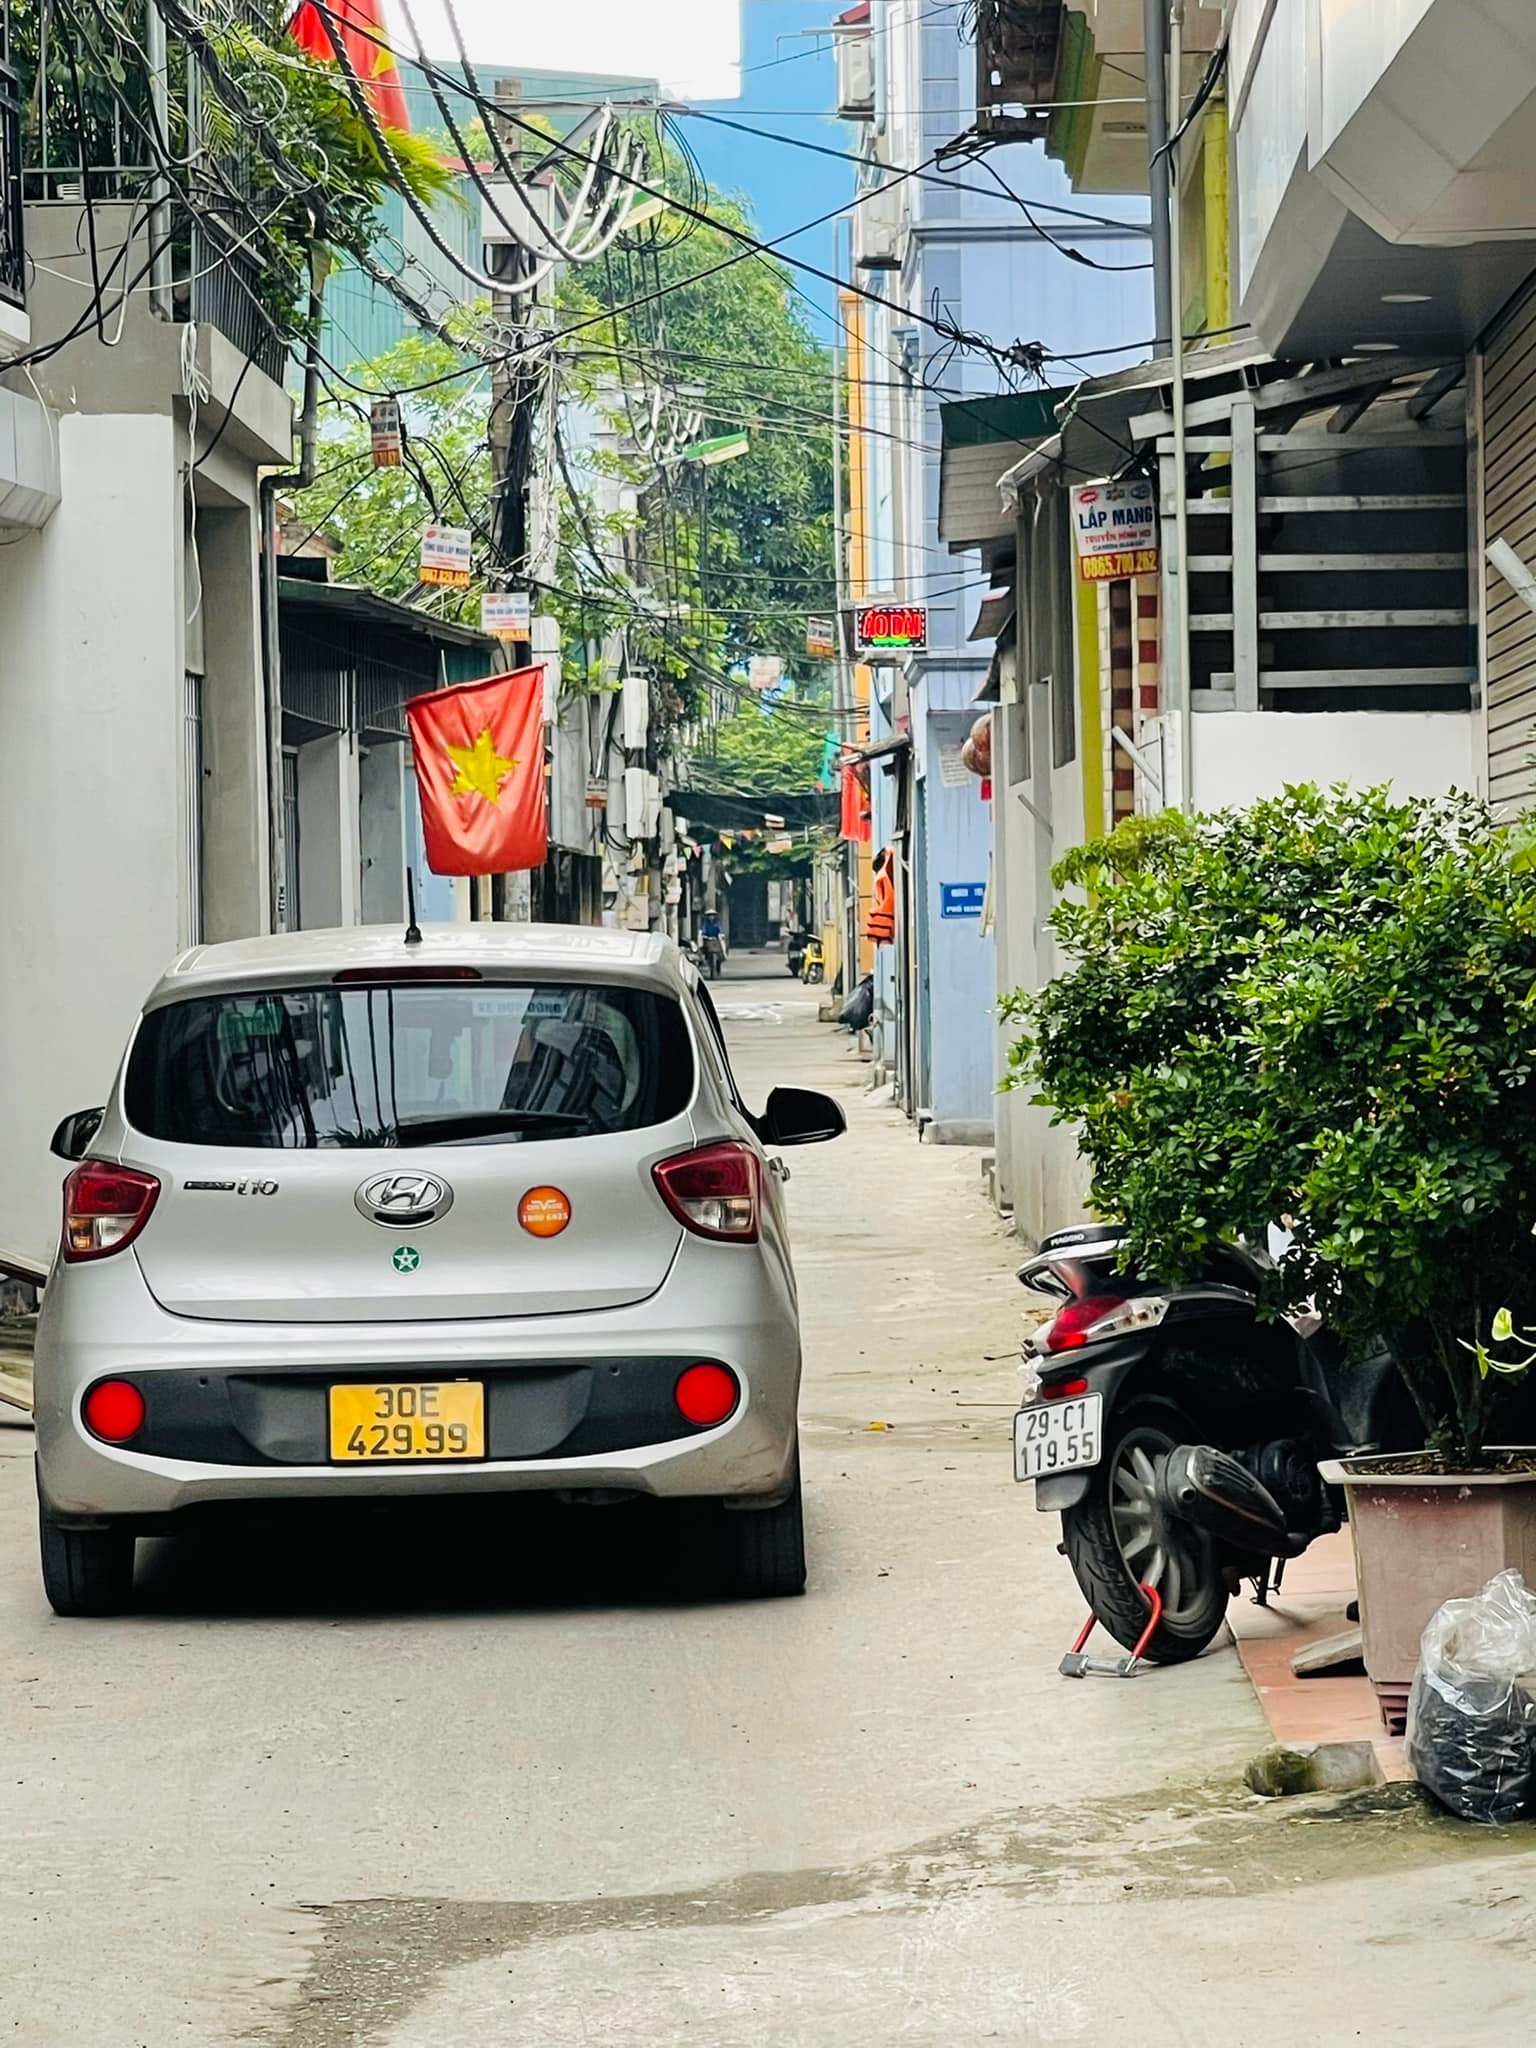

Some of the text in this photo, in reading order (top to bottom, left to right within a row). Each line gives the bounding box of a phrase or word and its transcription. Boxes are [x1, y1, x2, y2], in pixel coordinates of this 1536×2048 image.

[1112, 506, 1153, 529] MẠNG
[863, 610, 888, 638] ÁO
[374, 1386, 440, 1418] 30E
[1026, 1401, 1085, 1442] 29-C1
[347, 1423, 468, 1455] 429.99
[1021, 1431, 1094, 1475] 119.55
